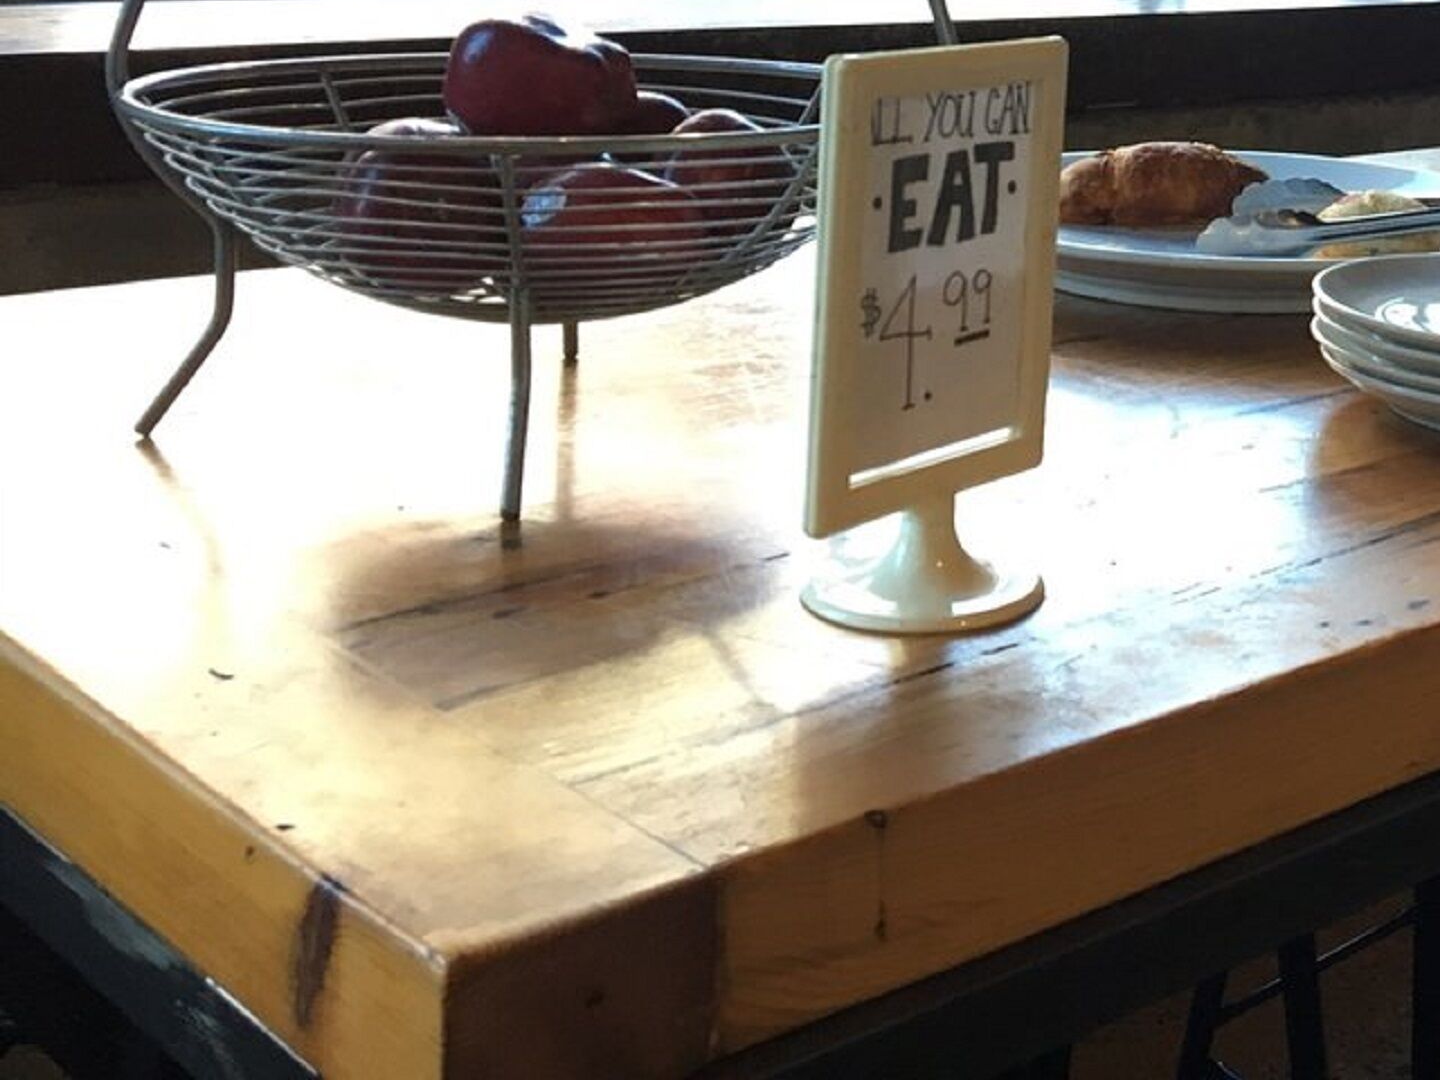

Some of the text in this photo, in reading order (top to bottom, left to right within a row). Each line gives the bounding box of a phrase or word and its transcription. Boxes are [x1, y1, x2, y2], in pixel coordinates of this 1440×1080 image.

[872, 79, 1032, 147] LL YOU CAN
[887, 140, 1015, 254] EAT
